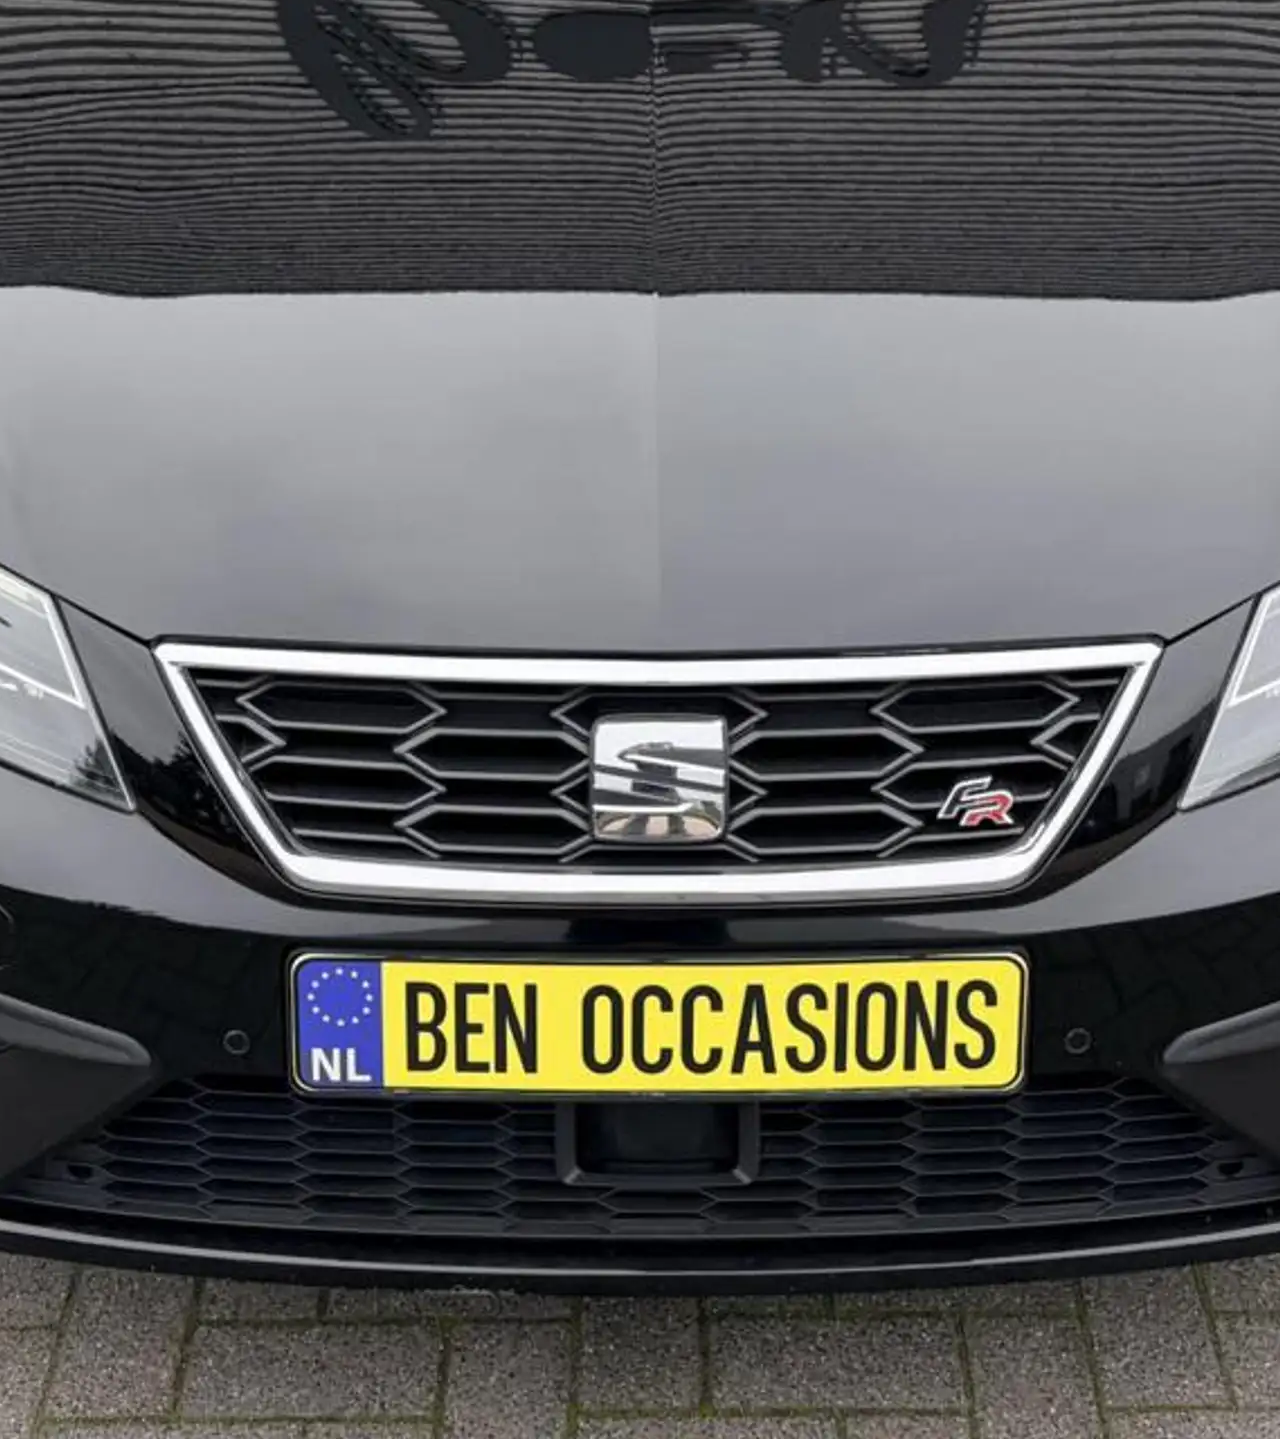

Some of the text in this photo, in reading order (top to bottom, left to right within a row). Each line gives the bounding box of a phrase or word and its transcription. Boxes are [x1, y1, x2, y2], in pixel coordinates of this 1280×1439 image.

[937, 775, 1014, 827] FR
[404, 979, 997, 1074] BEN OCCASIONS
[311, 1048, 371, 1083] NL
